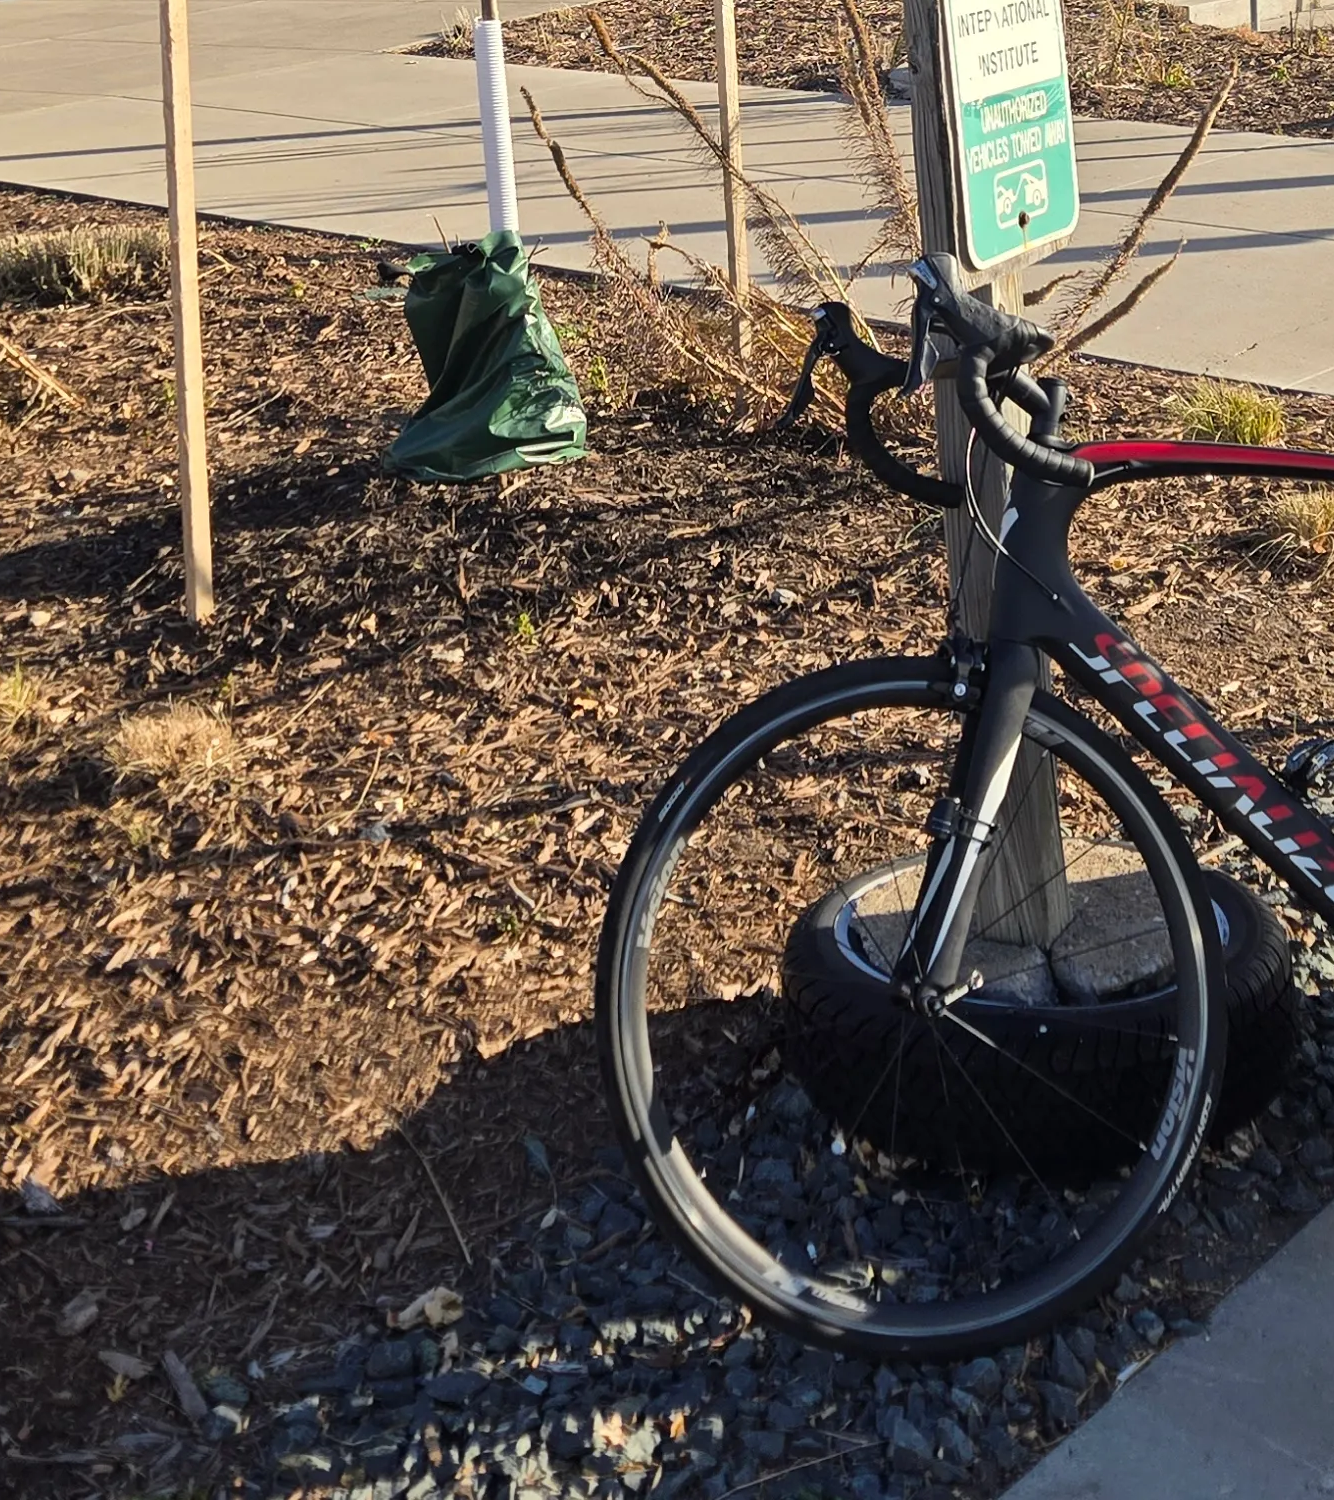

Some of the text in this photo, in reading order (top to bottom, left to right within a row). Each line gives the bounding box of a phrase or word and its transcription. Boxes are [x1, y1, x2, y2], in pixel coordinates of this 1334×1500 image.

[978, 40, 1039, 77] INSTITUTE
[980, 89, 1048, 135] UNAUTHORIZED
[966, 117, 1066, 175] VEHICLES TOWED AWAY
